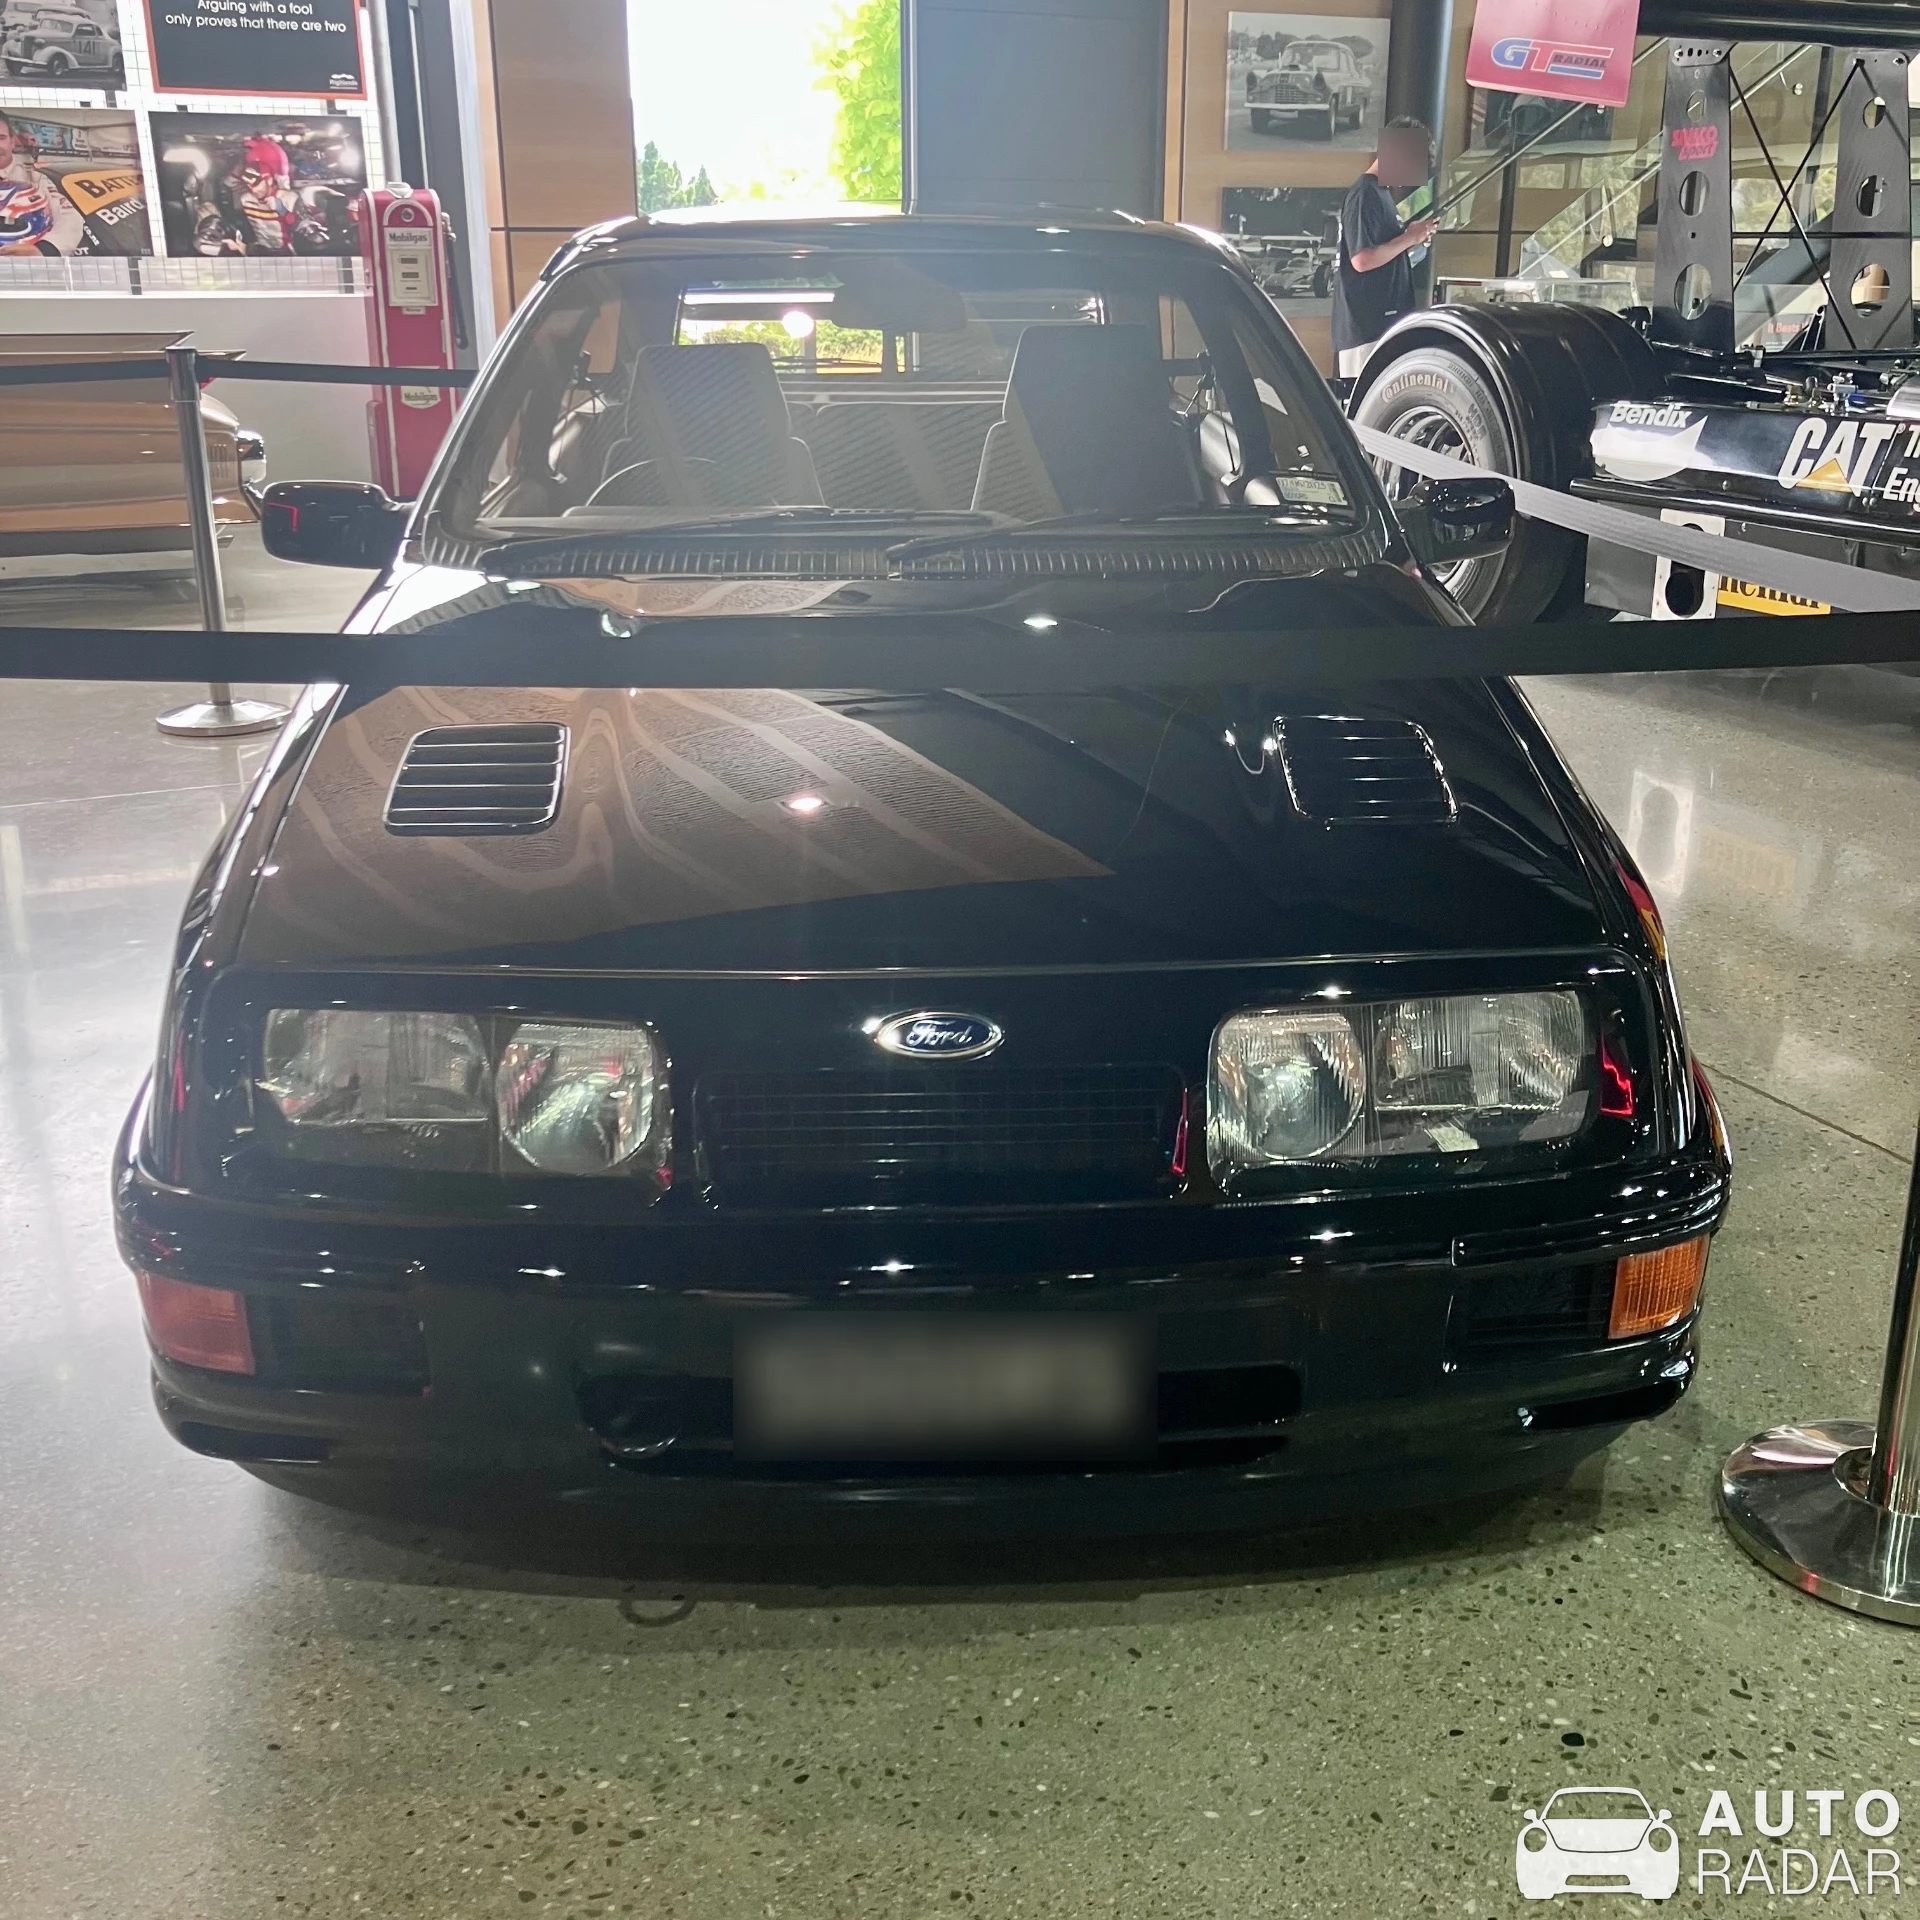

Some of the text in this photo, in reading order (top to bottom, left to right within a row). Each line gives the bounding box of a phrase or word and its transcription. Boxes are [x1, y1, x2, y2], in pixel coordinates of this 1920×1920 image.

[198, 0, 313, 15] Arguing with a fool
[165, 14, 347, 33] only proves that there are two
[1552, 53, 1607, 69] RADIAL
[388, 232, 428, 244] Mobilgas
[1381, 372, 1450, 404] Continental
[1609, 400, 1693, 428] Bendix
[906, 1019, 973, 1046] Ford
